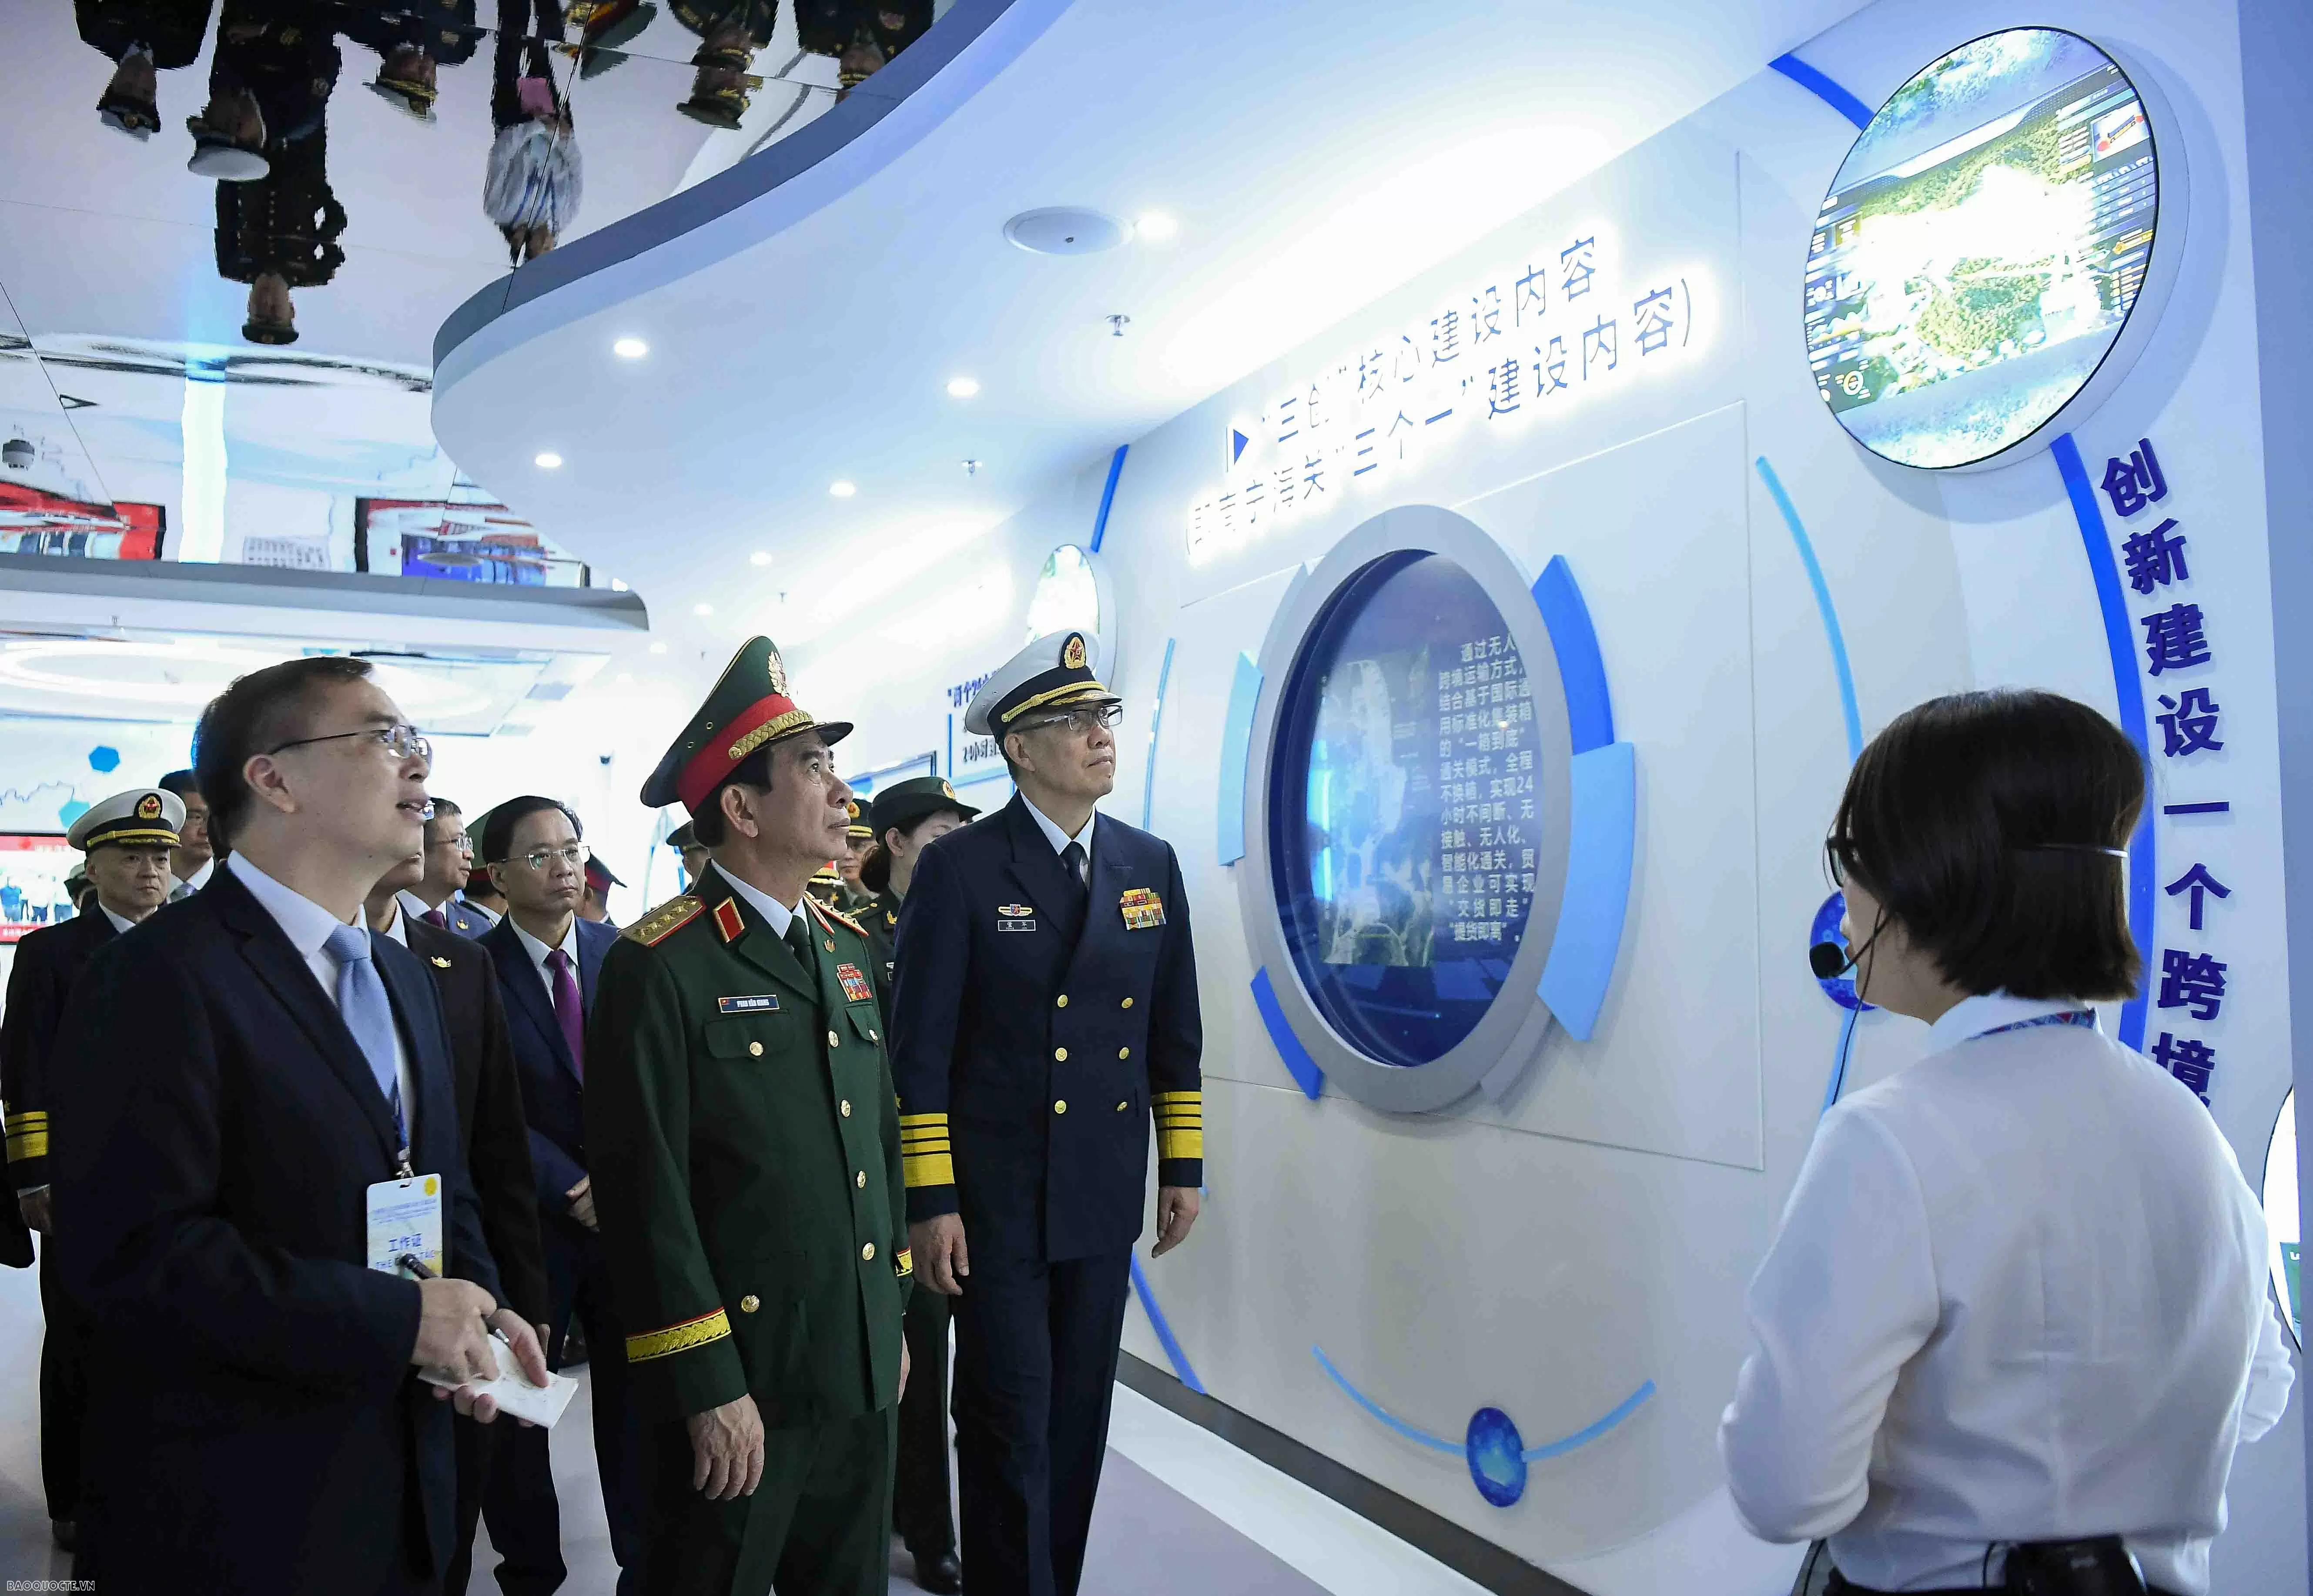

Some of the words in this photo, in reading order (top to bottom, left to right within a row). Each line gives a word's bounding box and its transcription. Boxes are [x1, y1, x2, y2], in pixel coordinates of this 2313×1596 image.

[2101, 437, 2231, 1108] 创新建设一个跨境
